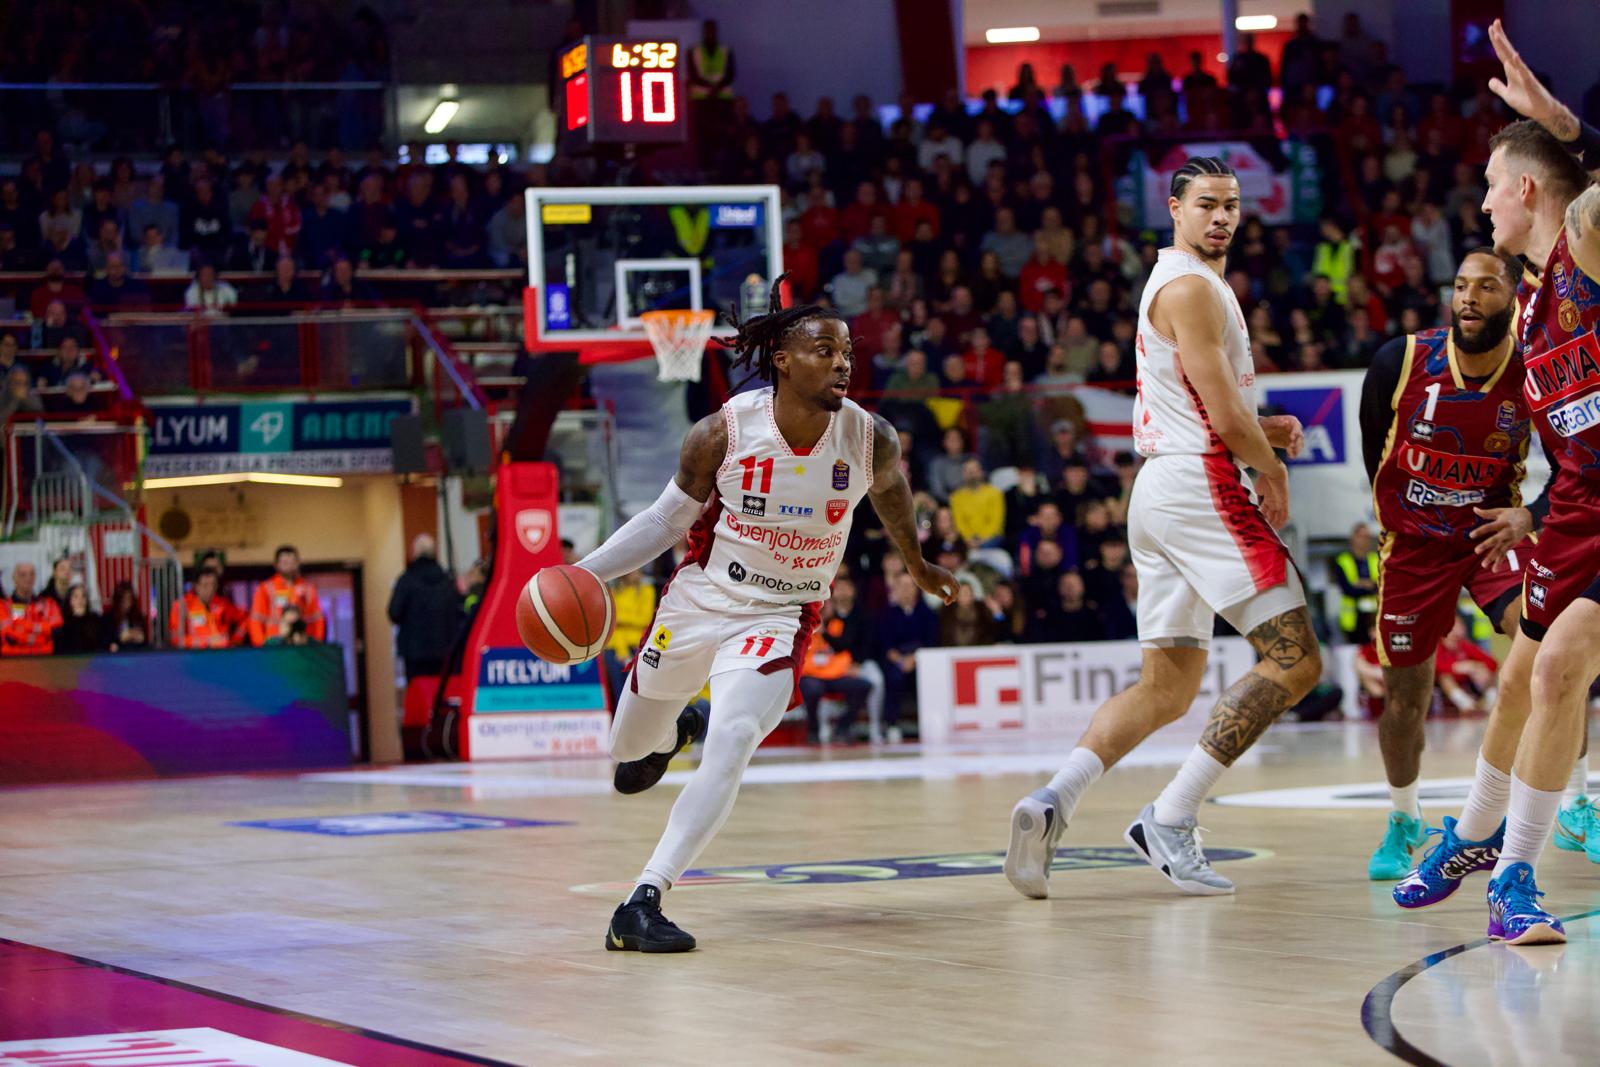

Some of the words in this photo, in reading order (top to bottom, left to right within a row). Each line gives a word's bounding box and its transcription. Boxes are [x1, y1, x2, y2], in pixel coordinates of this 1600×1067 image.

[612, 42, 677, 69] 6:52
[620, 71, 676, 122] 10
[1525, 344, 1600, 402] UMANA
[1424, 382, 1441, 421] 1
[738, 455, 774, 494] 11
[773, 551, 789, 564] by
[750, 572, 822, 592] motoola
[739, 635, 776, 658] 11
[486, 658, 571, 685] ITELYUM
